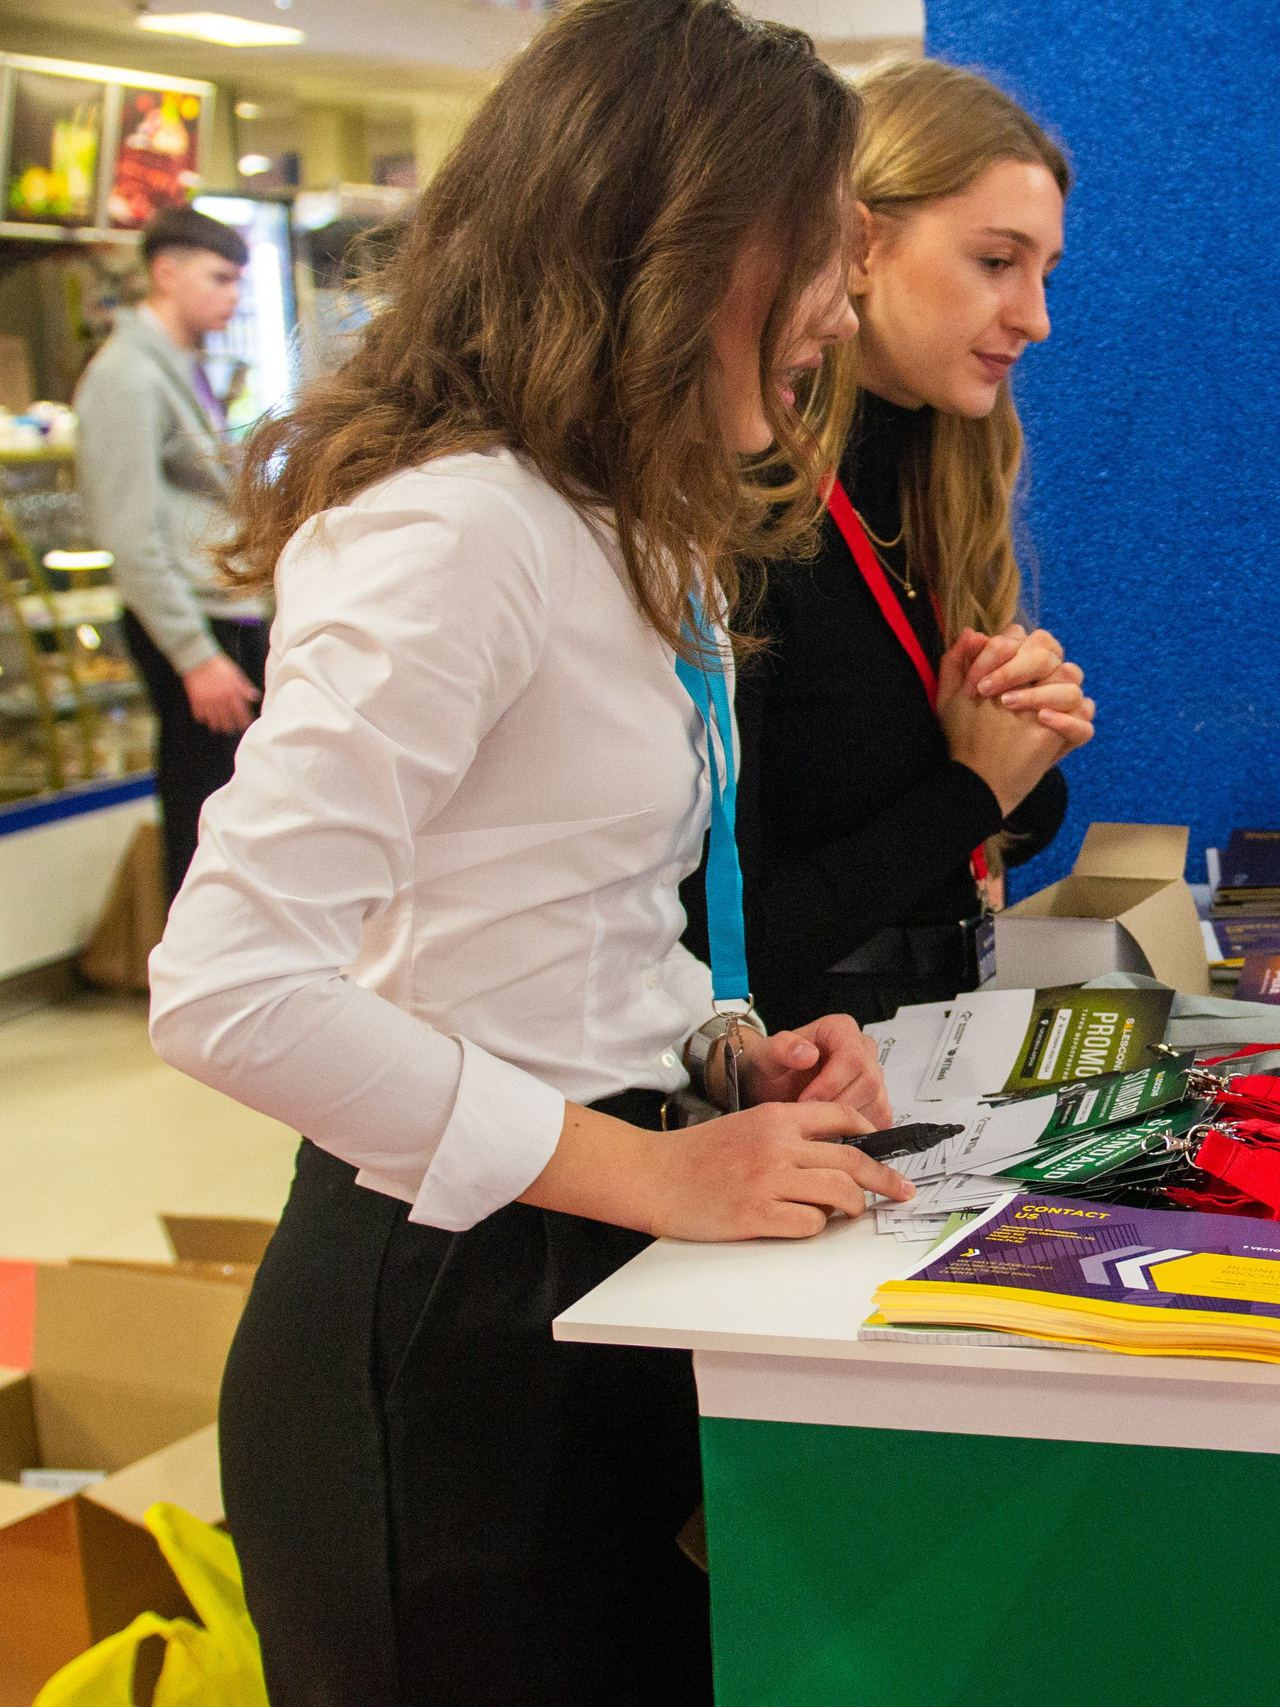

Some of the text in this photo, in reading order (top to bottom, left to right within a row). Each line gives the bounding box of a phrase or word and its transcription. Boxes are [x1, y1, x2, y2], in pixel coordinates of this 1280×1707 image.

[1074, 1012, 1119, 1077] PROMO
[1109, 1068, 1151, 1120] STANDARD
[1043, 1119, 1172, 1179] STANDARD
[1014, 1211, 1040, 1220] US
[1022, 1205, 1110, 1220] CONTACT
